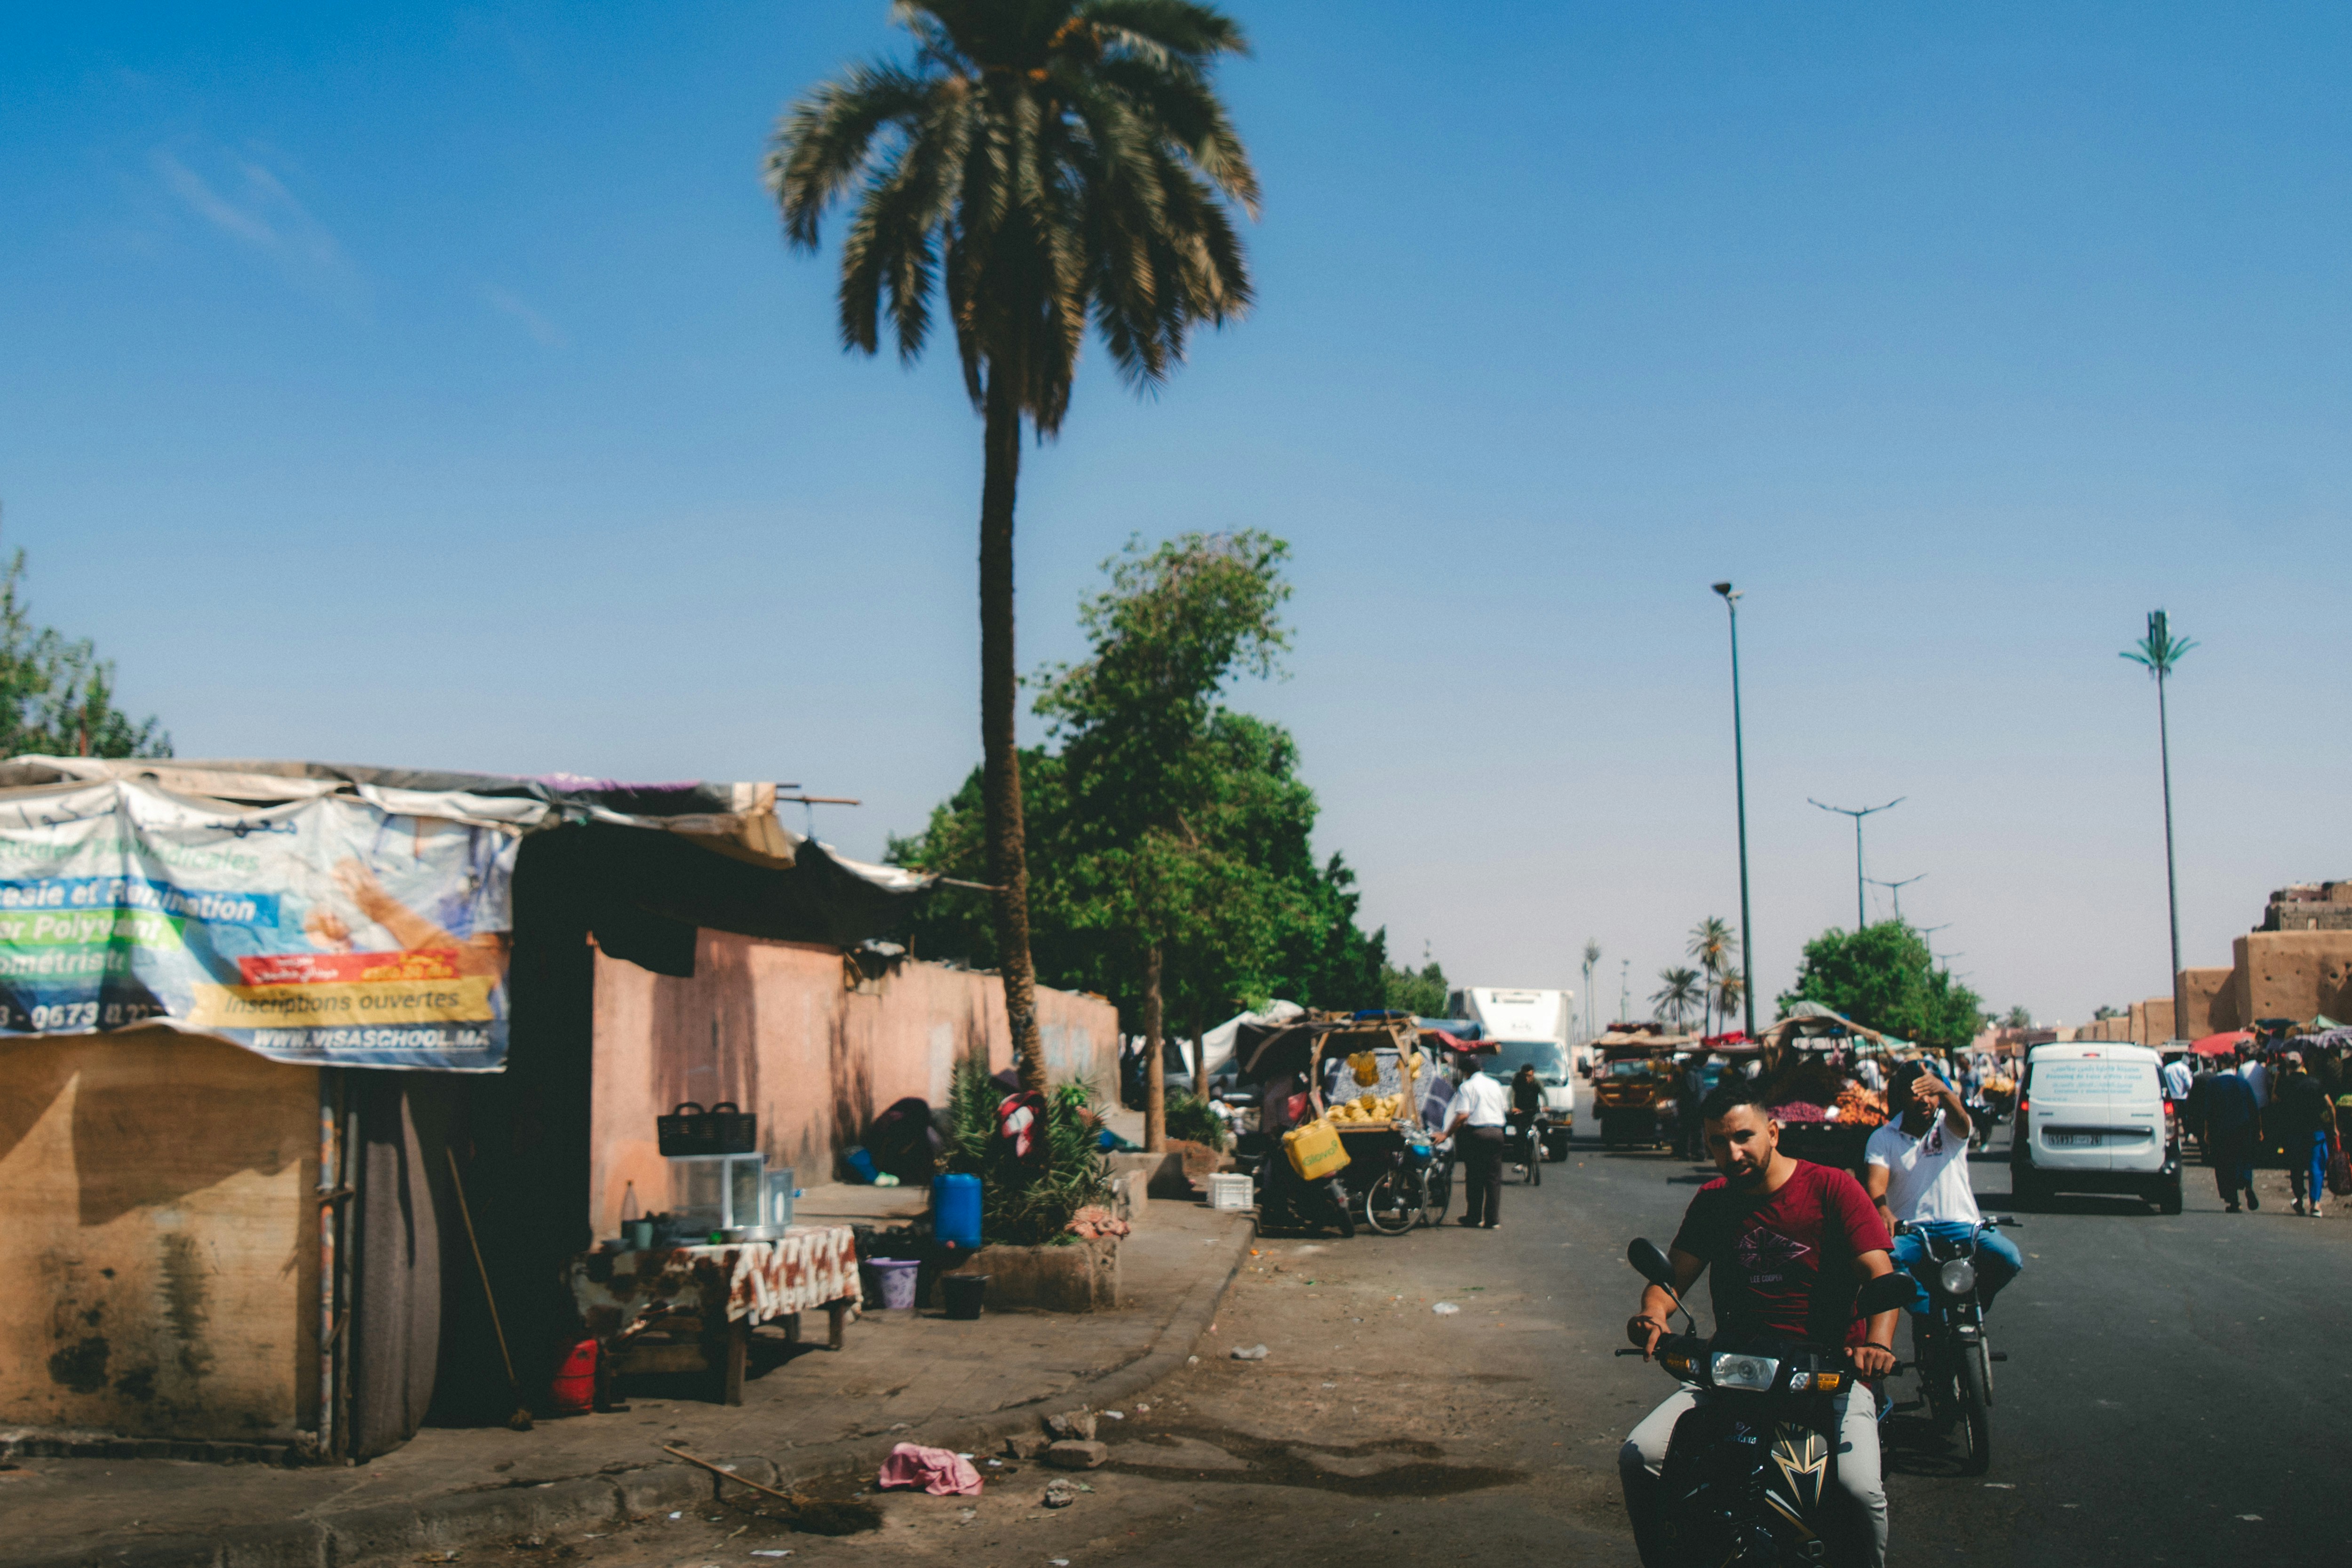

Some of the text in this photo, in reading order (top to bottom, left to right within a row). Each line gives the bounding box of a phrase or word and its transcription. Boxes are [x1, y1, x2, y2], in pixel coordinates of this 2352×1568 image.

[359, 991, 460, 1010] ouvertes
[31, 1001, 99, 1030] 0673
[1762, 1274, 1782, 1282] COOPER
